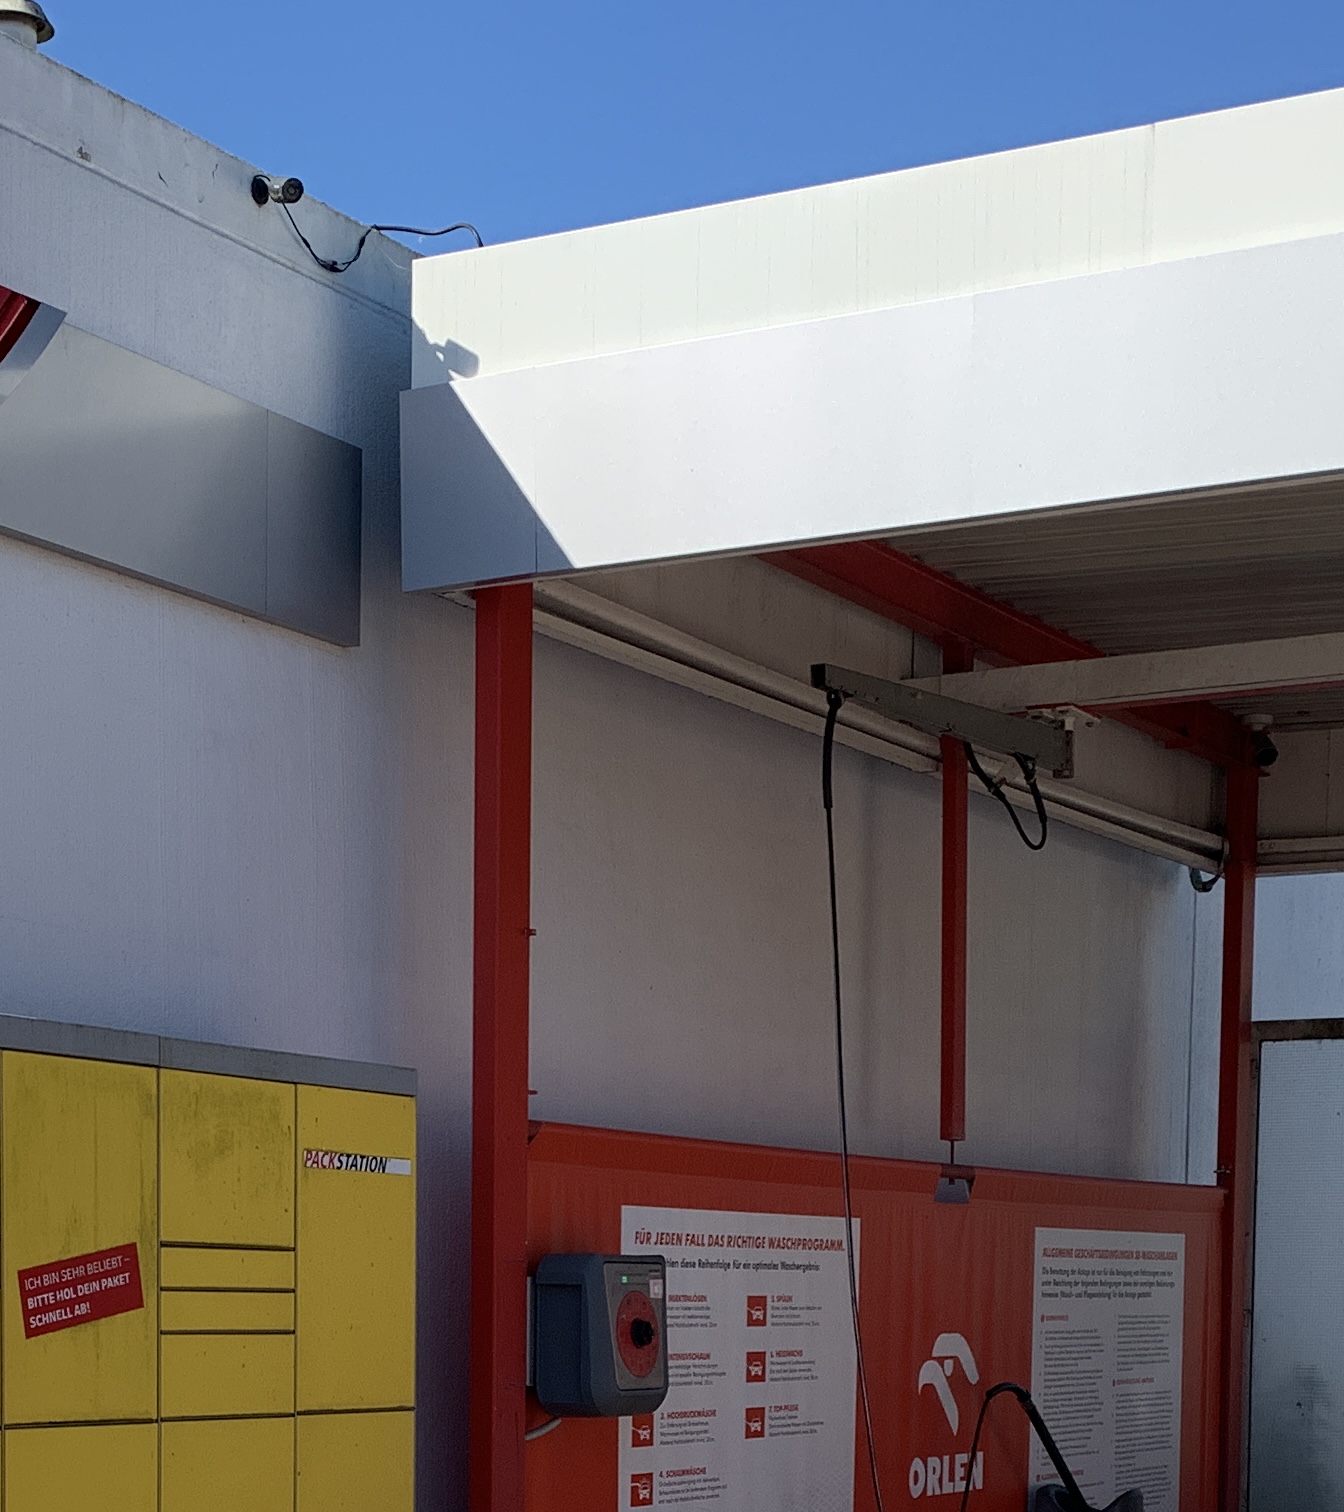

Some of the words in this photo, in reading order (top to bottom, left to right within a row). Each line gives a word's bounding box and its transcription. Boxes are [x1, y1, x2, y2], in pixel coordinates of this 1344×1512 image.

[304, 1150, 387, 1173] PACKSTATION
[634, 1228, 651, 1245] FÜR
[654, 1232, 682, 1246] JEDEN
[684, 1233, 705, 1247] FALL
[707, 1234, 725, 1248] DAS
[727, 1235, 766, 1249] RICHTIGE
[24, 1276, 42, 1291] ICH
[42, 1271, 60, 1286] BIN
[61, 1265, 86, 1282] SEHR
[86, 1255, 123, 1274] BELIEBT
[27, 1292, 55, 1309] BITTE
[56, 1288, 76, 1303] HOL
[77, 1280, 100, 1297] DEIN
[101, 1272, 131, 1290] PAKET
[29, 1306, 73, 1329] SCHNELL
[74, 1301, 91, 1316] AB!
[908, 1451, 984, 1499] ORLEN
